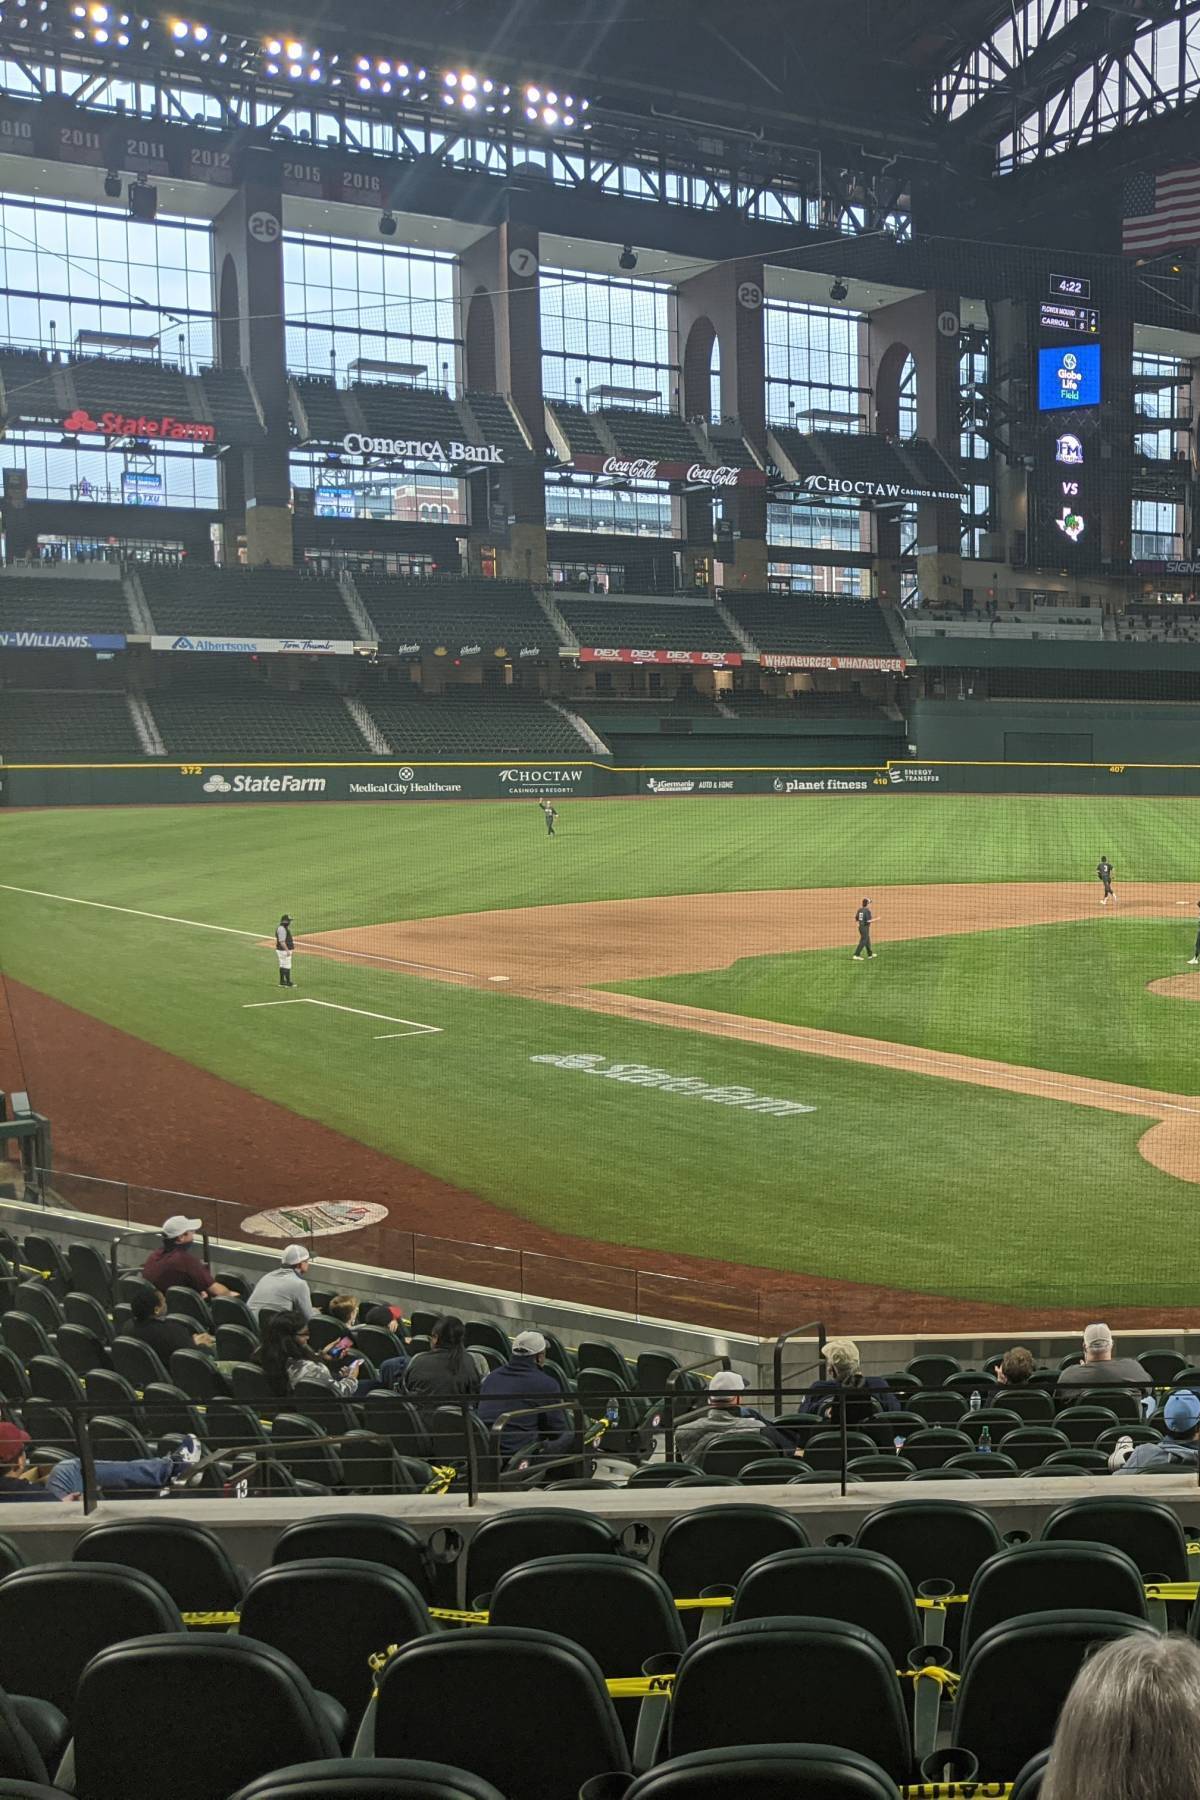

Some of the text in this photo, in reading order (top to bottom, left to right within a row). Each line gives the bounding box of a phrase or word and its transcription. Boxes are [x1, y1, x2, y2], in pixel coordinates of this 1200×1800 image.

[60, 128, 100, 149] 2011
[127, 139, 165, 159] 2011
[191, 148, 231, 168] 2012
[283, 162, 321, 182] 2015
[343, 171, 381, 191] 2016
[252, 217, 277, 235] 26
[518, 254, 529, 271] 7
[1059, 280, 1082, 293] 4:22
[740, 286, 761, 303] 29
[941, 316, 955, 332] 10
[1042, 317, 1070, 328] CARROLL
[1058, 369, 1082, 381] Globe
[1062, 379, 1078, 390] Life
[1061, 390, 1079, 400] Field
[449, 442, 505, 464] Bank
[602, 456, 660, 479] Coca-Cola
[686, 463, 741, 486] Coca-Cola
[814, 475, 967, 501] CHOCTAW CASINOS RESORTS
[1062, 482, 1078, 495] VS
[195, 641, 258, 652] Albertsons
[279, 639, 334, 650] Tom Thumb
[593, 648, 727, 660] DEX DEX DEX DEX
[764, 655, 902, 670] WHATABURGER WHATABURGER
[180, 766, 202, 775] 372
[507, 769, 583, 782] CHOCTAW
[660, 780, 734, 789] Germania AUTO HOME
[785, 778, 868, 792] planet fitness
[873, 777, 888, 785] 410
[349, 782, 462, 795] Medical City Healthcare
[236, 1479, 248, 1500] 13
